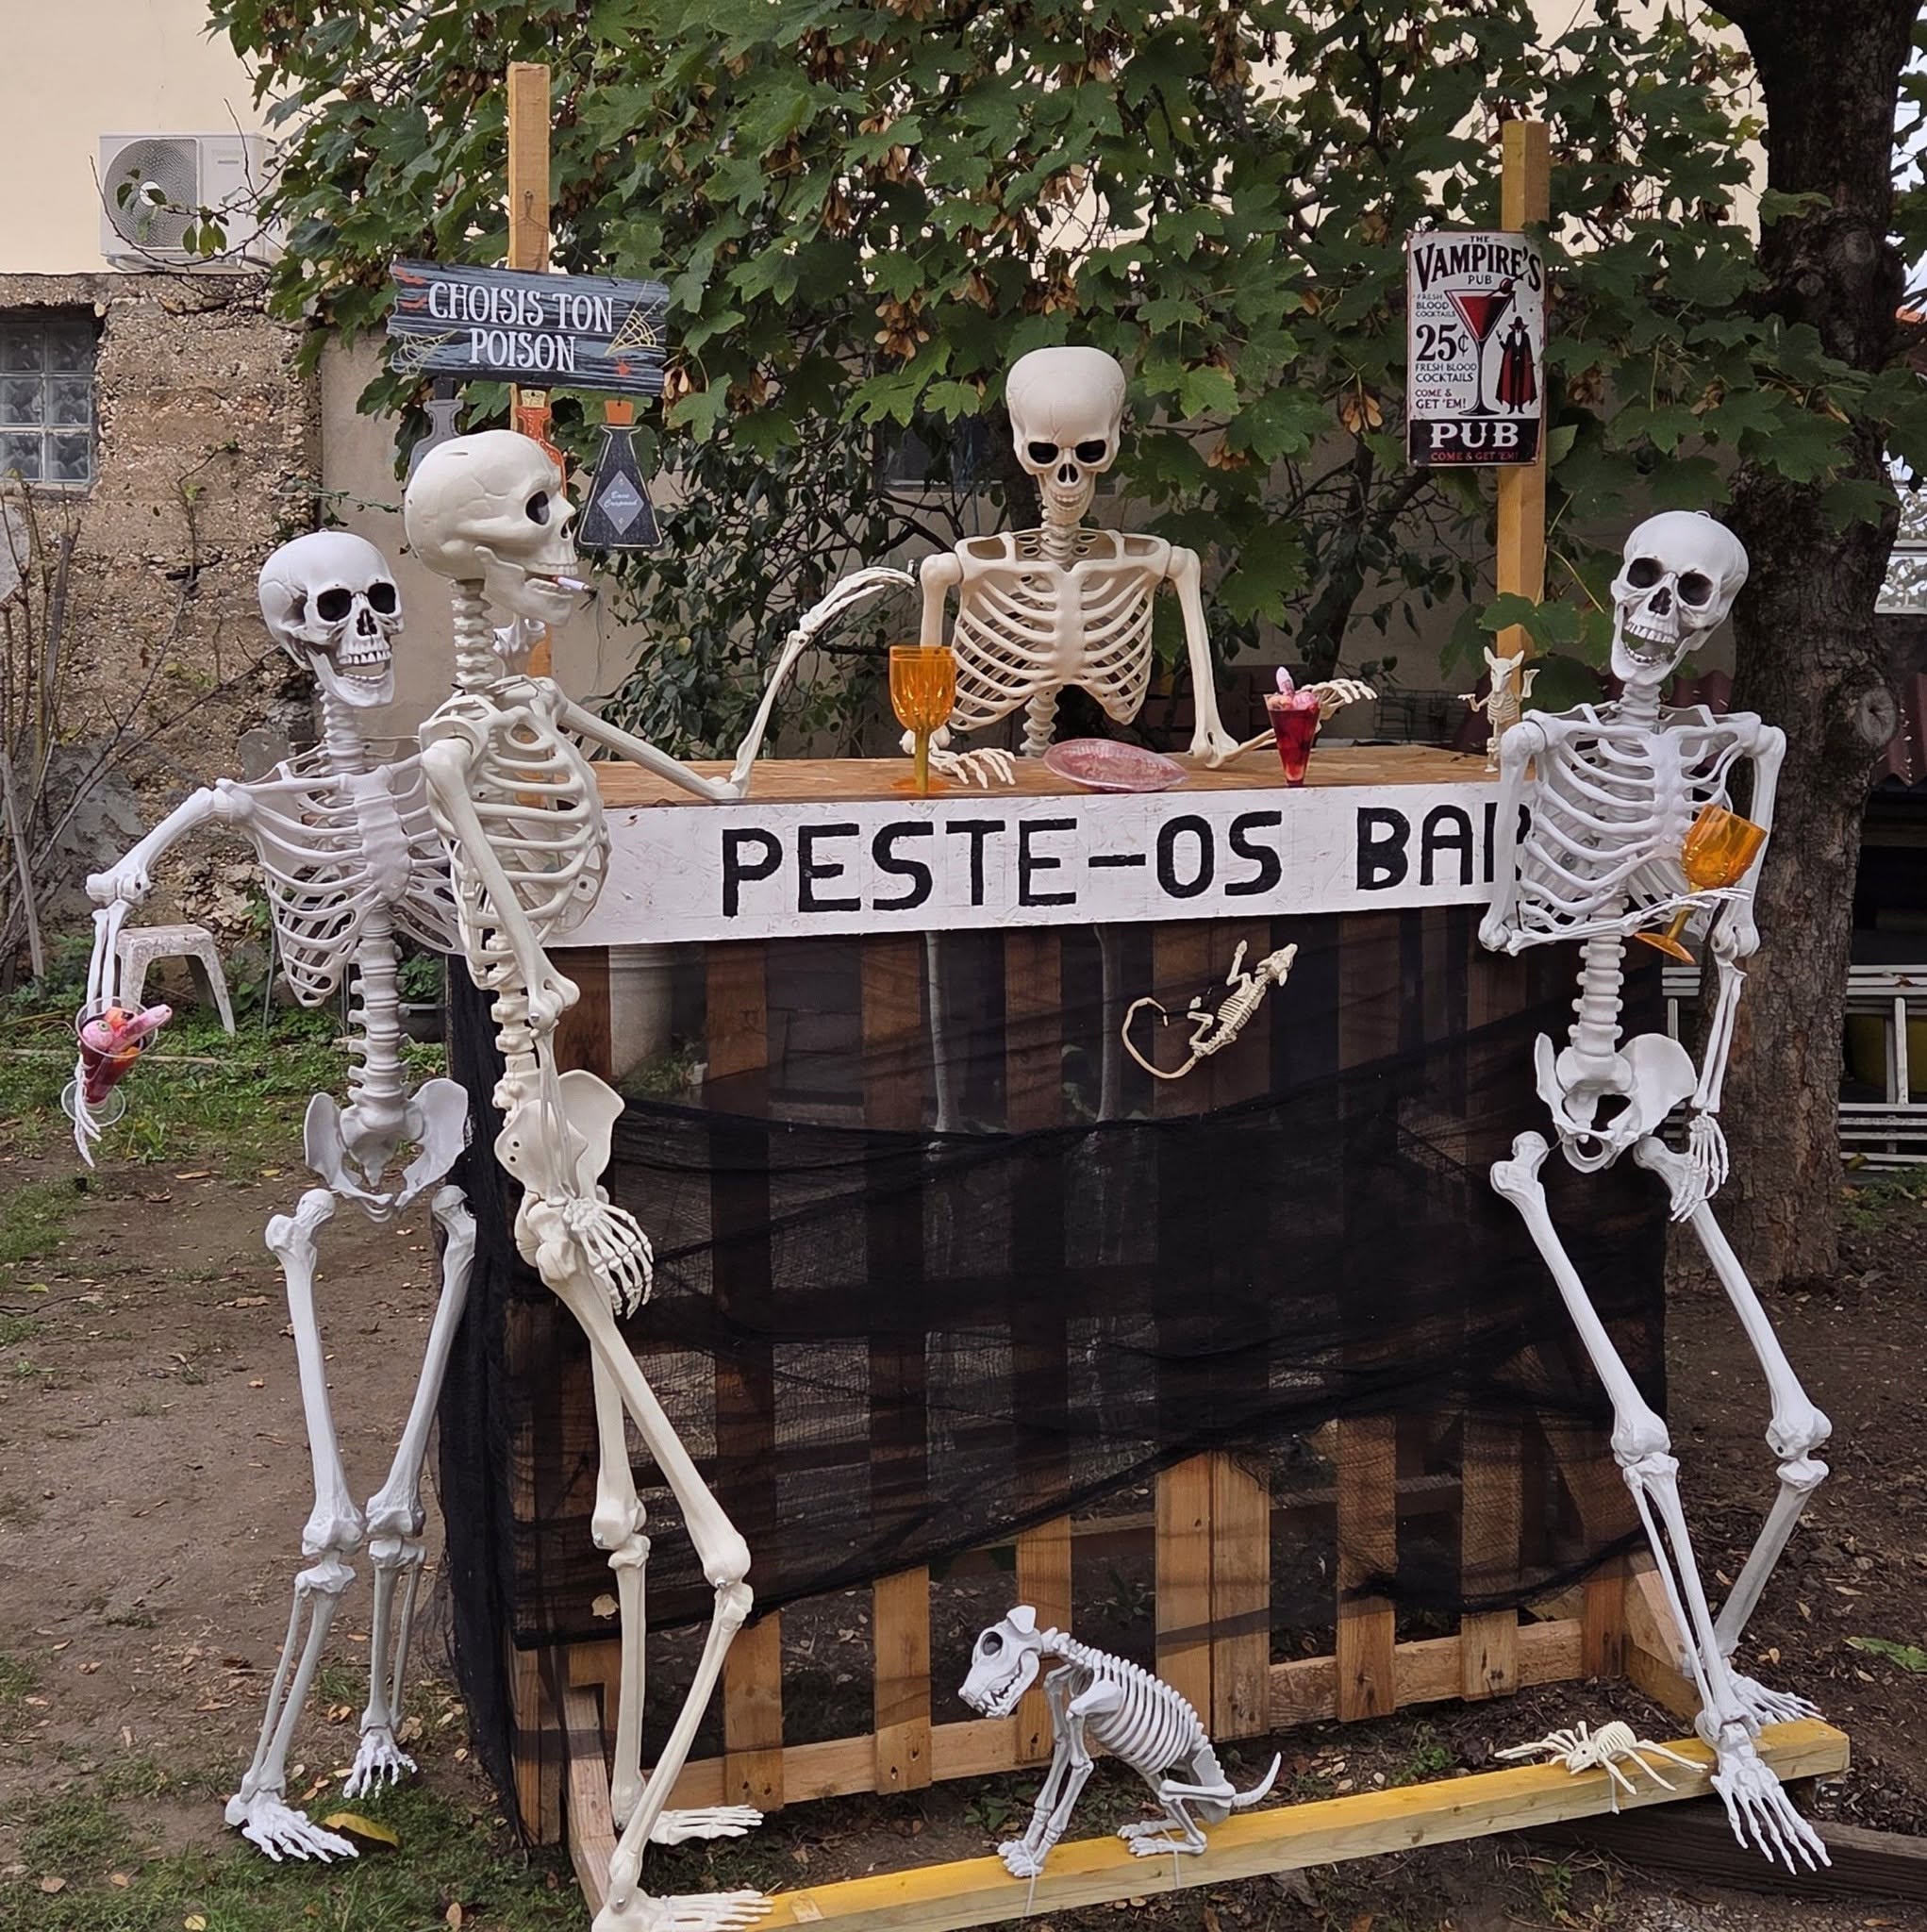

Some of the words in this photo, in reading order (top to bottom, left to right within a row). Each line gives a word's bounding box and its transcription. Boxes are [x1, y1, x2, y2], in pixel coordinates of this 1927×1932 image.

[1413, 242, 1541, 292] VAMPIRE'S
[1468, 275, 1493, 285] PUB
[428, 282, 545, 327] CHOISIS
[552, 292, 614, 334] TON
[1416, 301, 1449, 309] BLOOD
[469, 328, 575, 372] POISON
[1415, 362, 1444, 372] FRESH
[1446, 362, 1477, 372] BLOOD
[1415, 372, 1474, 383] COCKTAILS
[1415, 389, 1442, 397] COME
[1444, 388, 1453, 397] &
[1416, 398, 1440, 409] GET
[1429, 422, 1520, 448] PUB
[1430, 452, 1463, 461] COME
[1465, 451, 1472, 460] &
[1474, 452, 1496, 460] GET
[723, 810, 1283, 918] PESTE-OS
